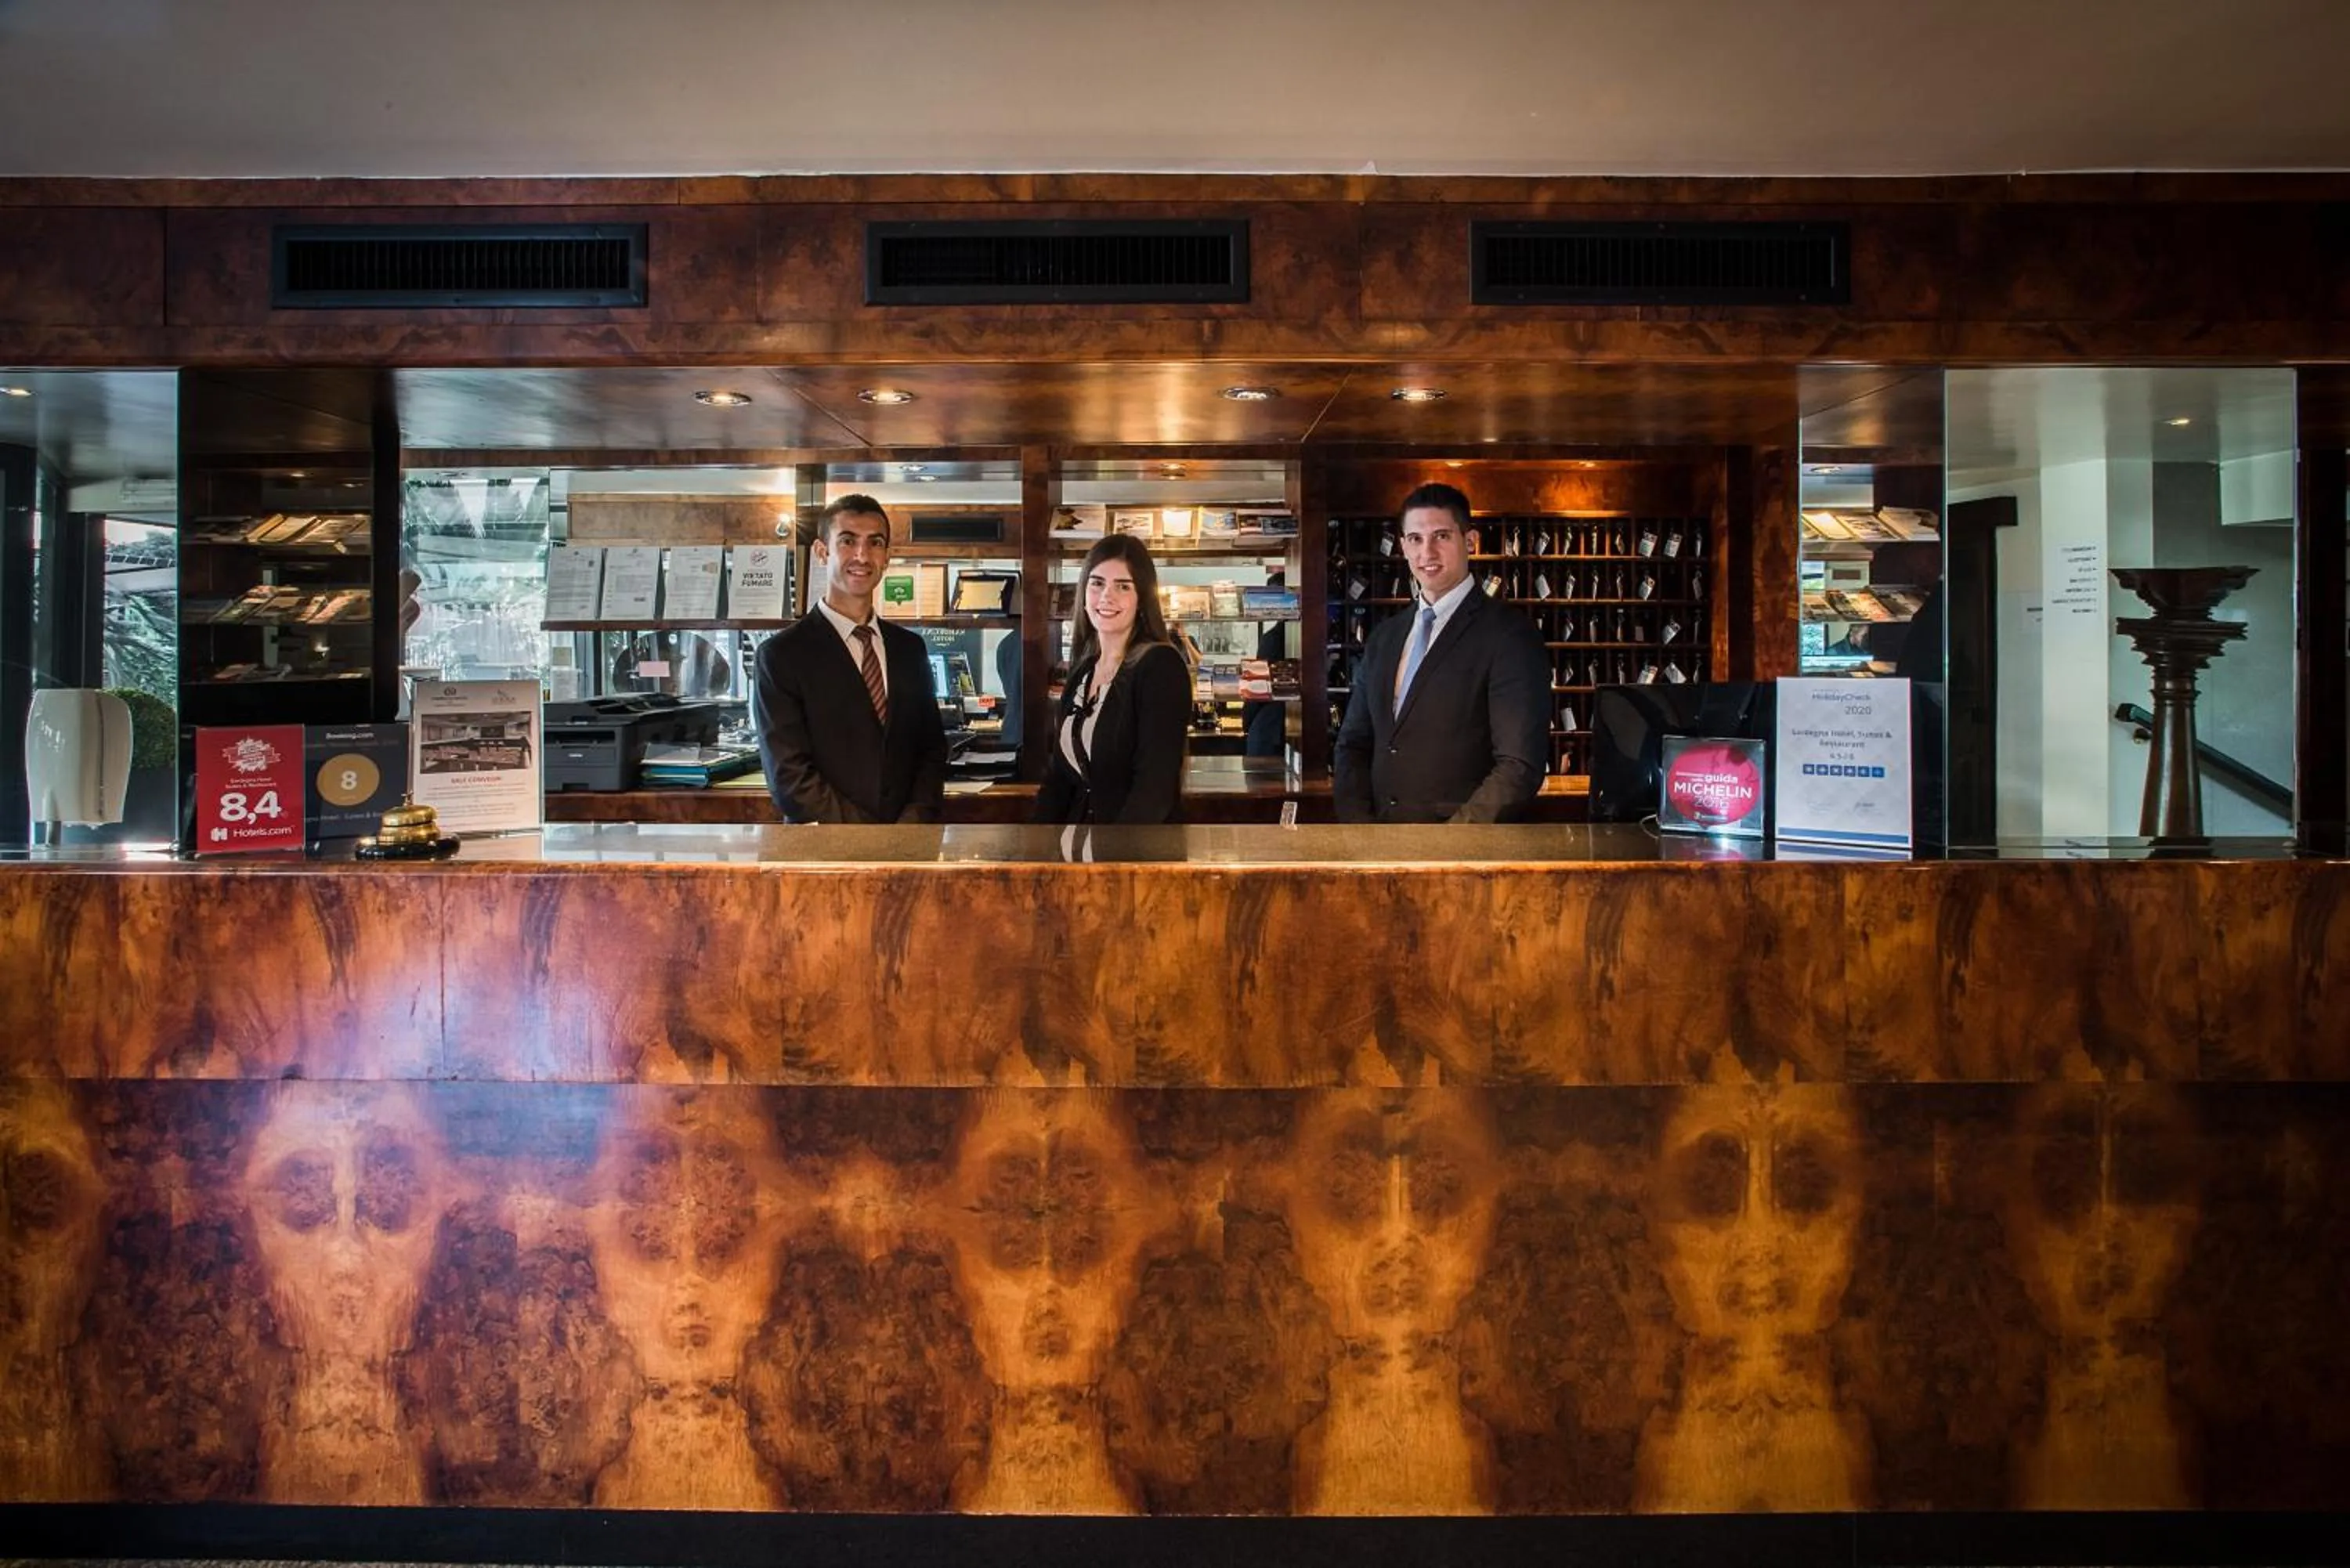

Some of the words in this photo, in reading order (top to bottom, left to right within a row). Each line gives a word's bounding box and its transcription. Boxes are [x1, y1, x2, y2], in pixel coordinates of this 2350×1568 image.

[1844, 706, 1872, 715] 2020
[341, 771, 357, 790] 8
[1704, 773, 1738, 784] guida
[1674, 781, 1752, 799] MICHELIN
[219, 790, 282, 825] 8,4
[233, 826, 292, 837] Hotels.com
